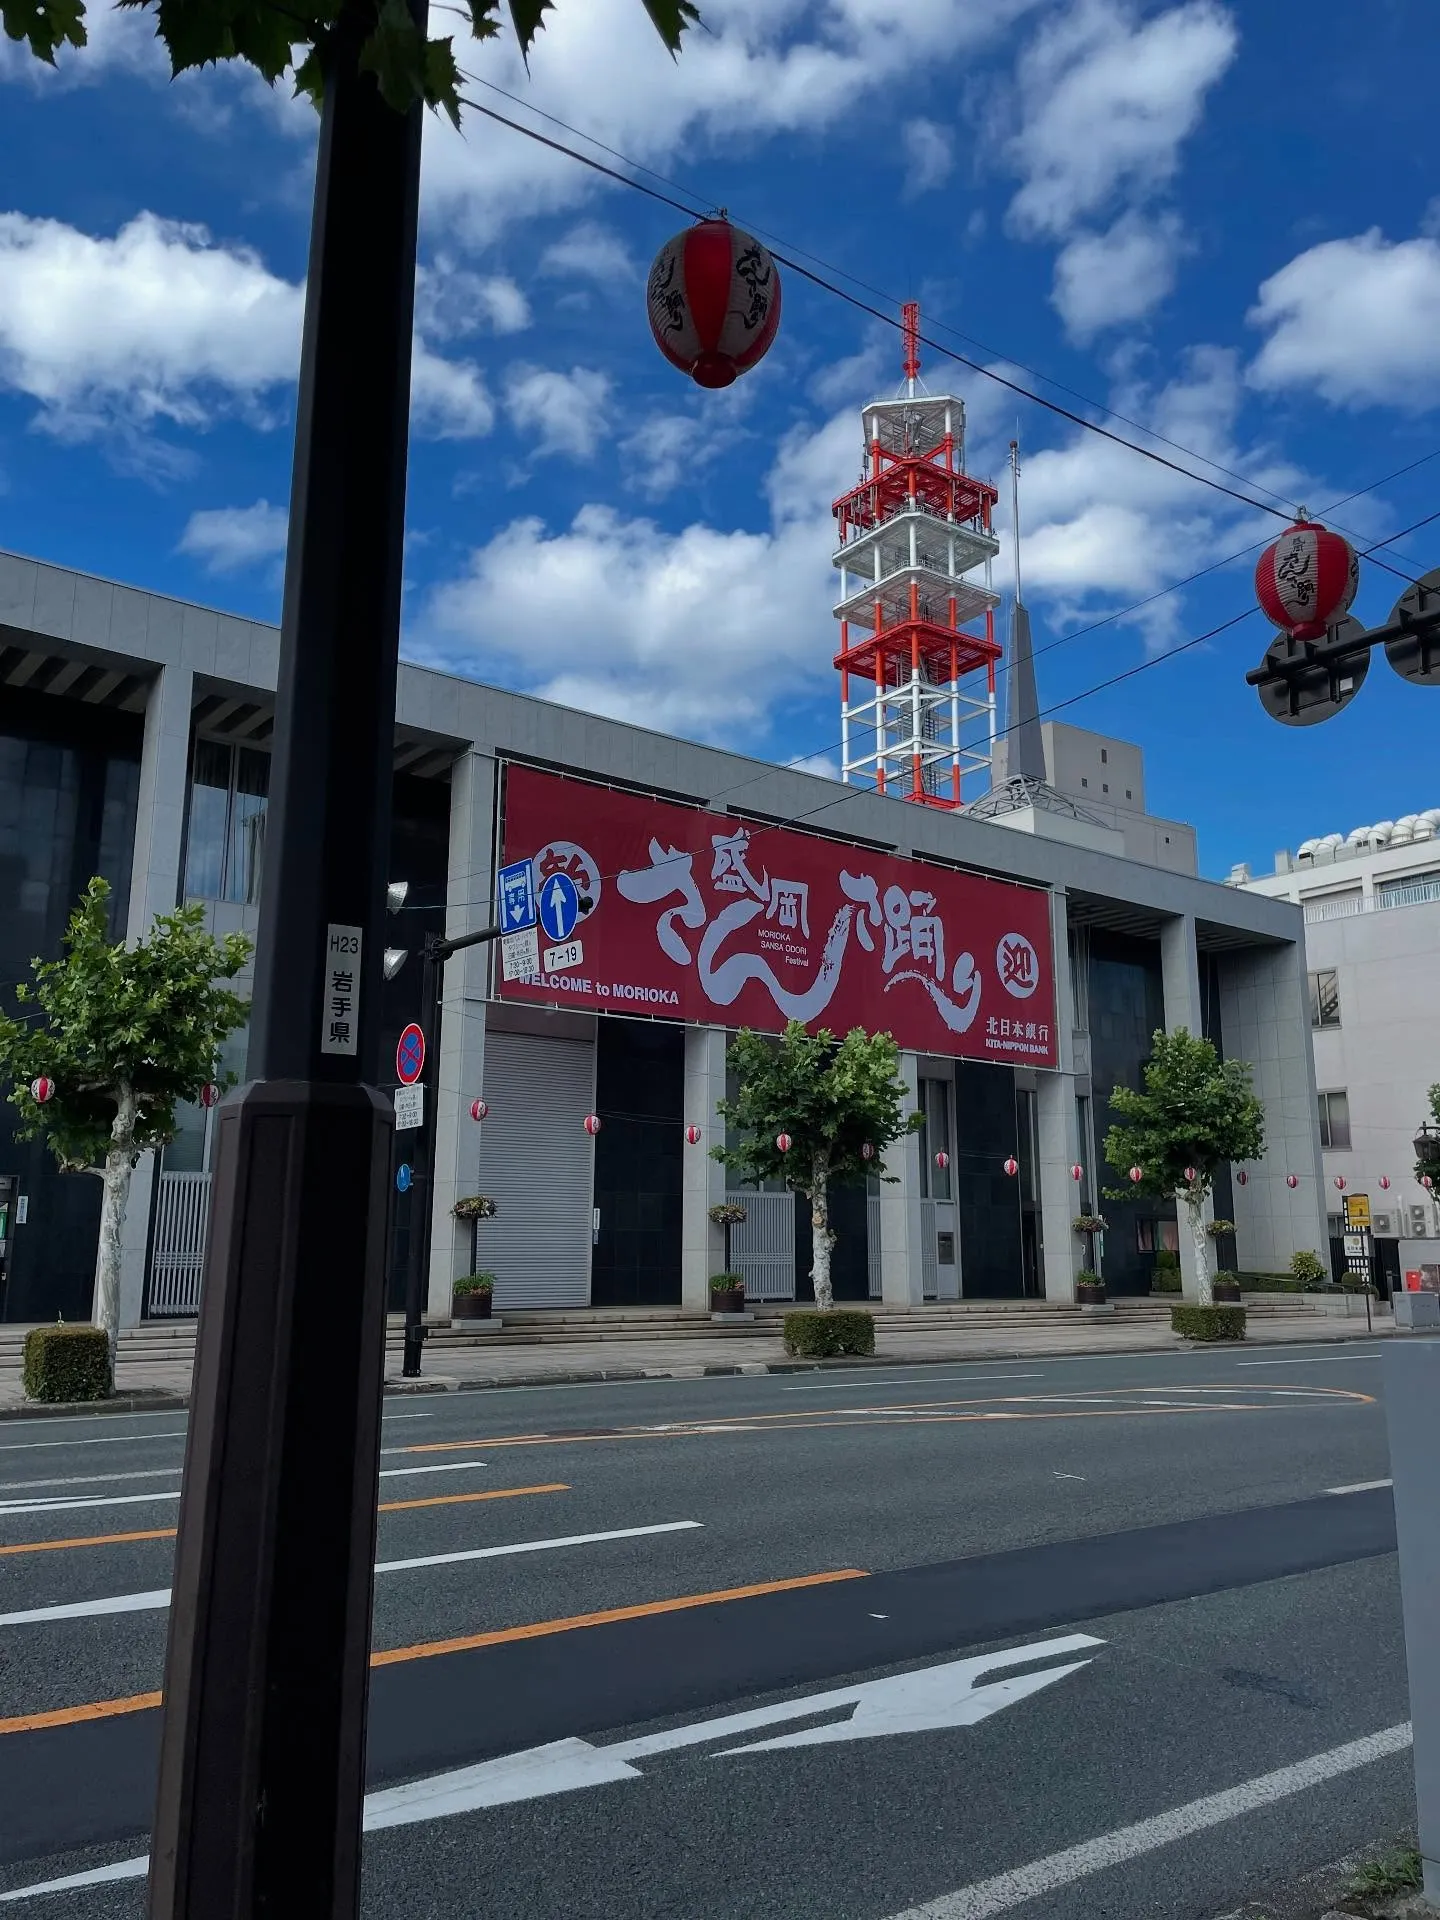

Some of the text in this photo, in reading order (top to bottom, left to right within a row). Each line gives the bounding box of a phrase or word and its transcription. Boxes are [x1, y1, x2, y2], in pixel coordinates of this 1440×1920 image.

[330, 935, 359, 954] H23
[758, 929, 791, 941] MORIOKA
[549, 946, 577, 967] 7-19
[761, 941, 807, 955] SANSA ODORI
[785, 955, 809, 967] Festival
[1002, 939, 1035, 989] 迎
[519, 972, 680, 1005] WELCOME to MORIOKA
[329, 970, 353, 1043] 岩手県
[985, 1016, 1049, 1042] 北日本銀行
[985, 1038, 1049, 1056] KITA-NIPPON BANK
